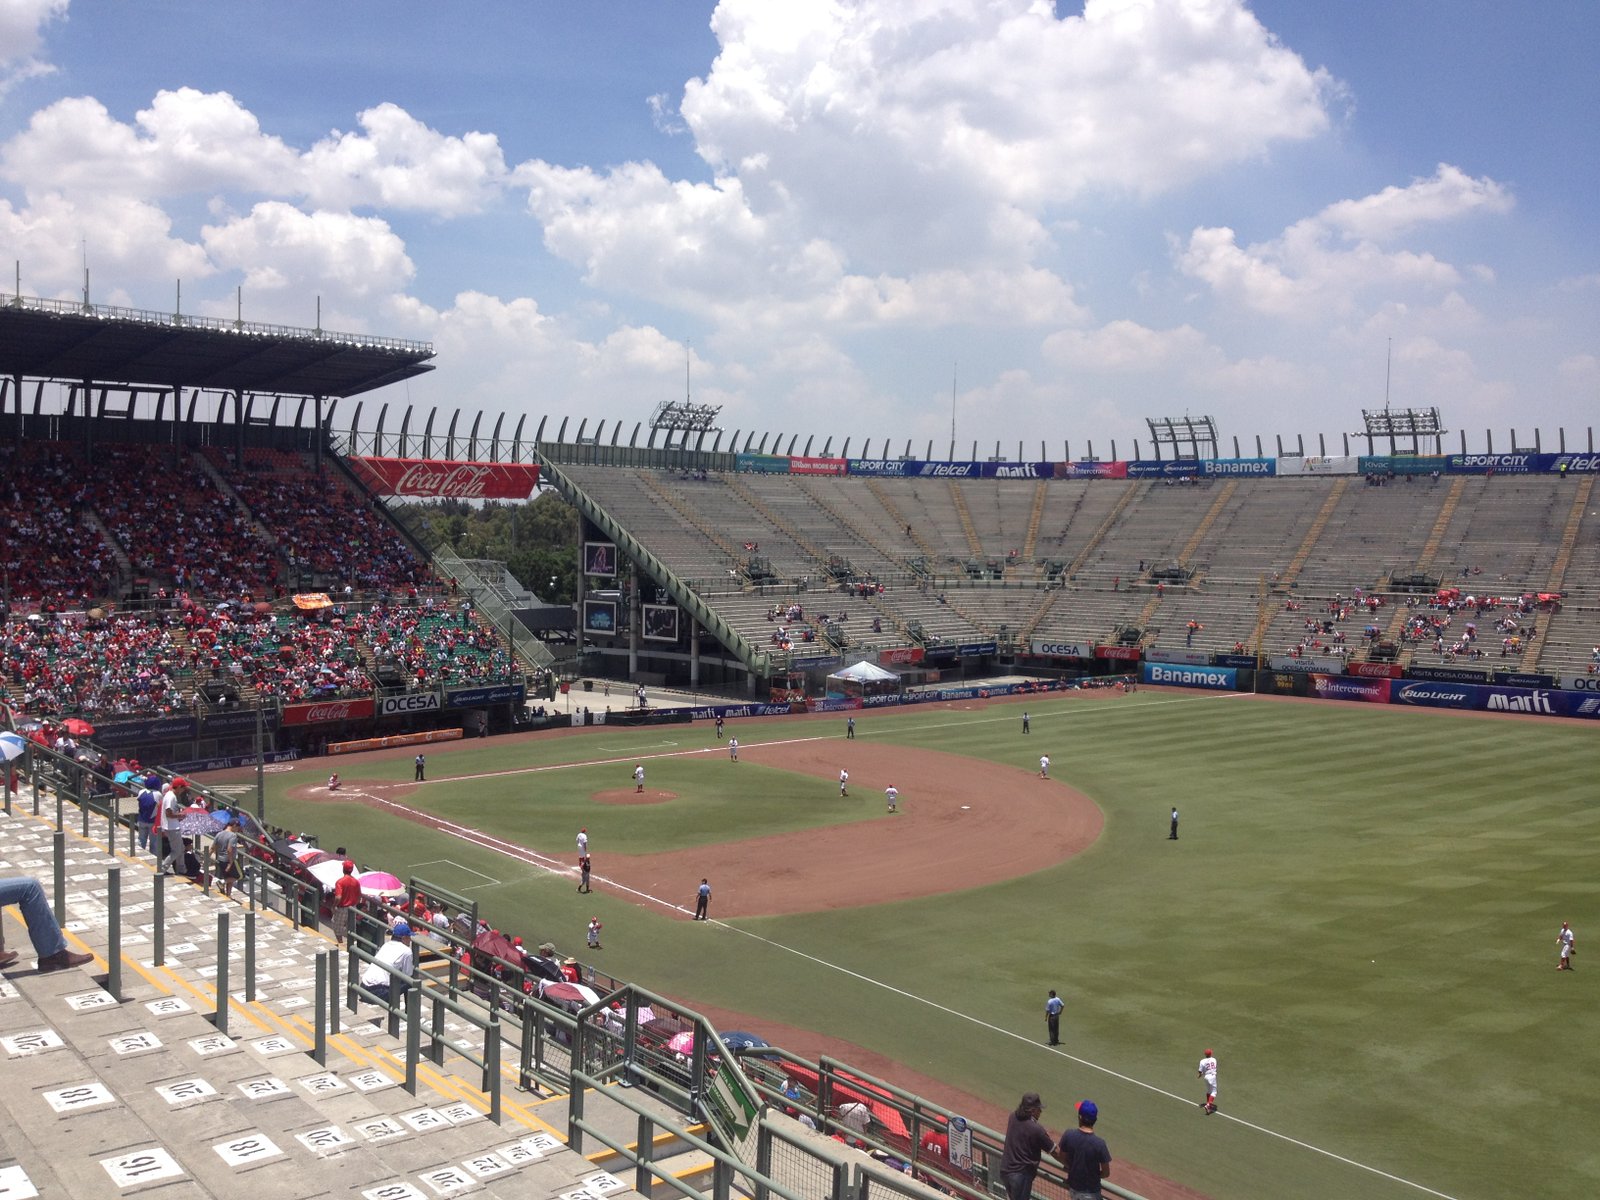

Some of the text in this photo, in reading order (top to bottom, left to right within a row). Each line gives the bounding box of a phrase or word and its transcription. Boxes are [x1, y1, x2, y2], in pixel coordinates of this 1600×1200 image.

[858, 461, 906, 470] SPORT CITY
[1205, 461, 1268, 473] Banamex
[1464, 456, 1528, 465] SPORT CITY
[934, 464, 969, 476] telcel
[395, 463, 491, 497] Coca-Cola
[1042, 644, 1080, 656] OCESA
[1152, 666, 1227, 686] Banamex
[1358, 664, 1390, 676] Coca-Cola
[942, 691, 973, 700] Banamex
[1327, 682, 1382, 696] Interceramic
[1405, 690, 1467, 700] BUD LIGHT
[386, 695, 438, 712] OCESA
[869, 694, 900, 703] SPORT CITY
[307, 702, 349, 721] Coca-Cola
[764, 705, 790, 714] telcel
[154, 1000, 181, 1012] 26
[13, 1034, 48, 1050] 20
[198, 1037, 226, 1050] 24
[260, 1040, 285, 1051] 26
[310, 1077, 337, 1090] 24
[358, 1074, 383, 1086] 26
[168, 1082, 203, 1098] 20
[249, 1080, 279, 1094] 22
[59, 1088, 98, 1104] 18
[411, 1112, 438, 1126] 24
[447, 1107, 472, 1119] 26
[307, 1130, 341, 1146] 20
[529, 1137, 553, 1149] 26
[229, 1140, 266, 1157] 18
[119, 1156, 162, 1176] 16
[472, 1157, 502, 1172] 22
[431, 1172, 464, 1187] 20
[591, 1175, 617, 1189] 24
[377, 1186, 412, 1200] 18
